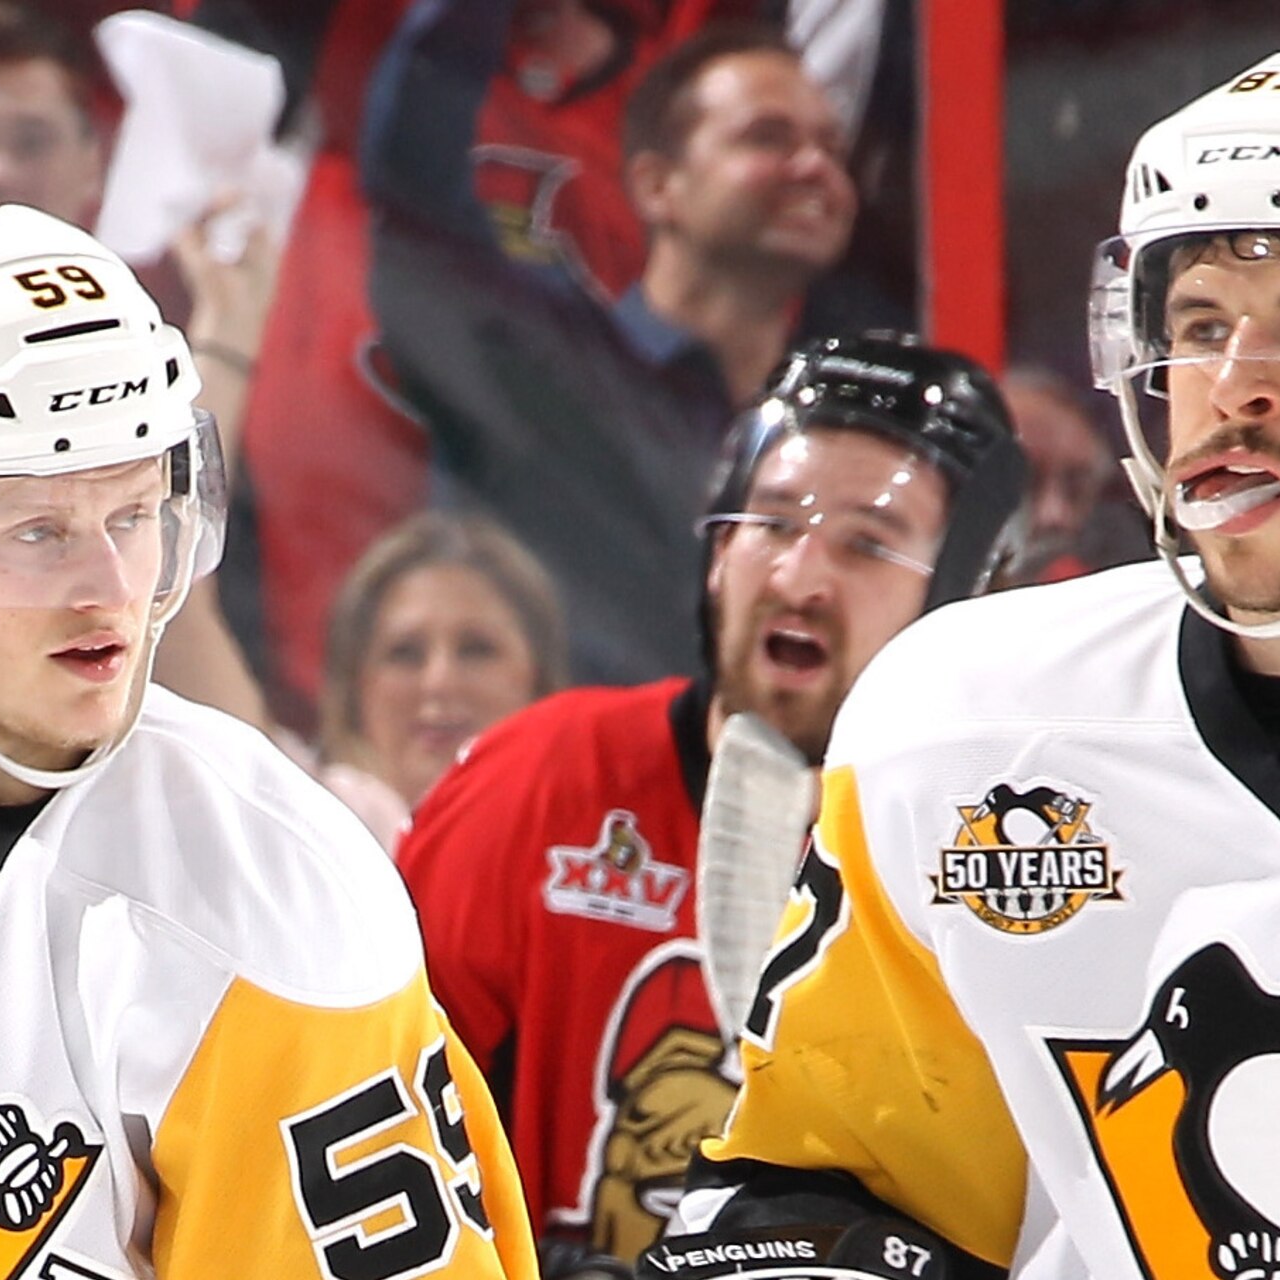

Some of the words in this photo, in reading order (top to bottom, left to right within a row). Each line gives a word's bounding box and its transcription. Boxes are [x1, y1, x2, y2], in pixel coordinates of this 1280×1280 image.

[13, 265, 107, 309] 59
[49, 376, 150, 413] CCM
[945, 852, 987, 889] 50
[998, 850, 1104, 886] YEARS
[667, 1240, 816, 1272] PENGUINS
[882, 1236, 931, 1277] 87
